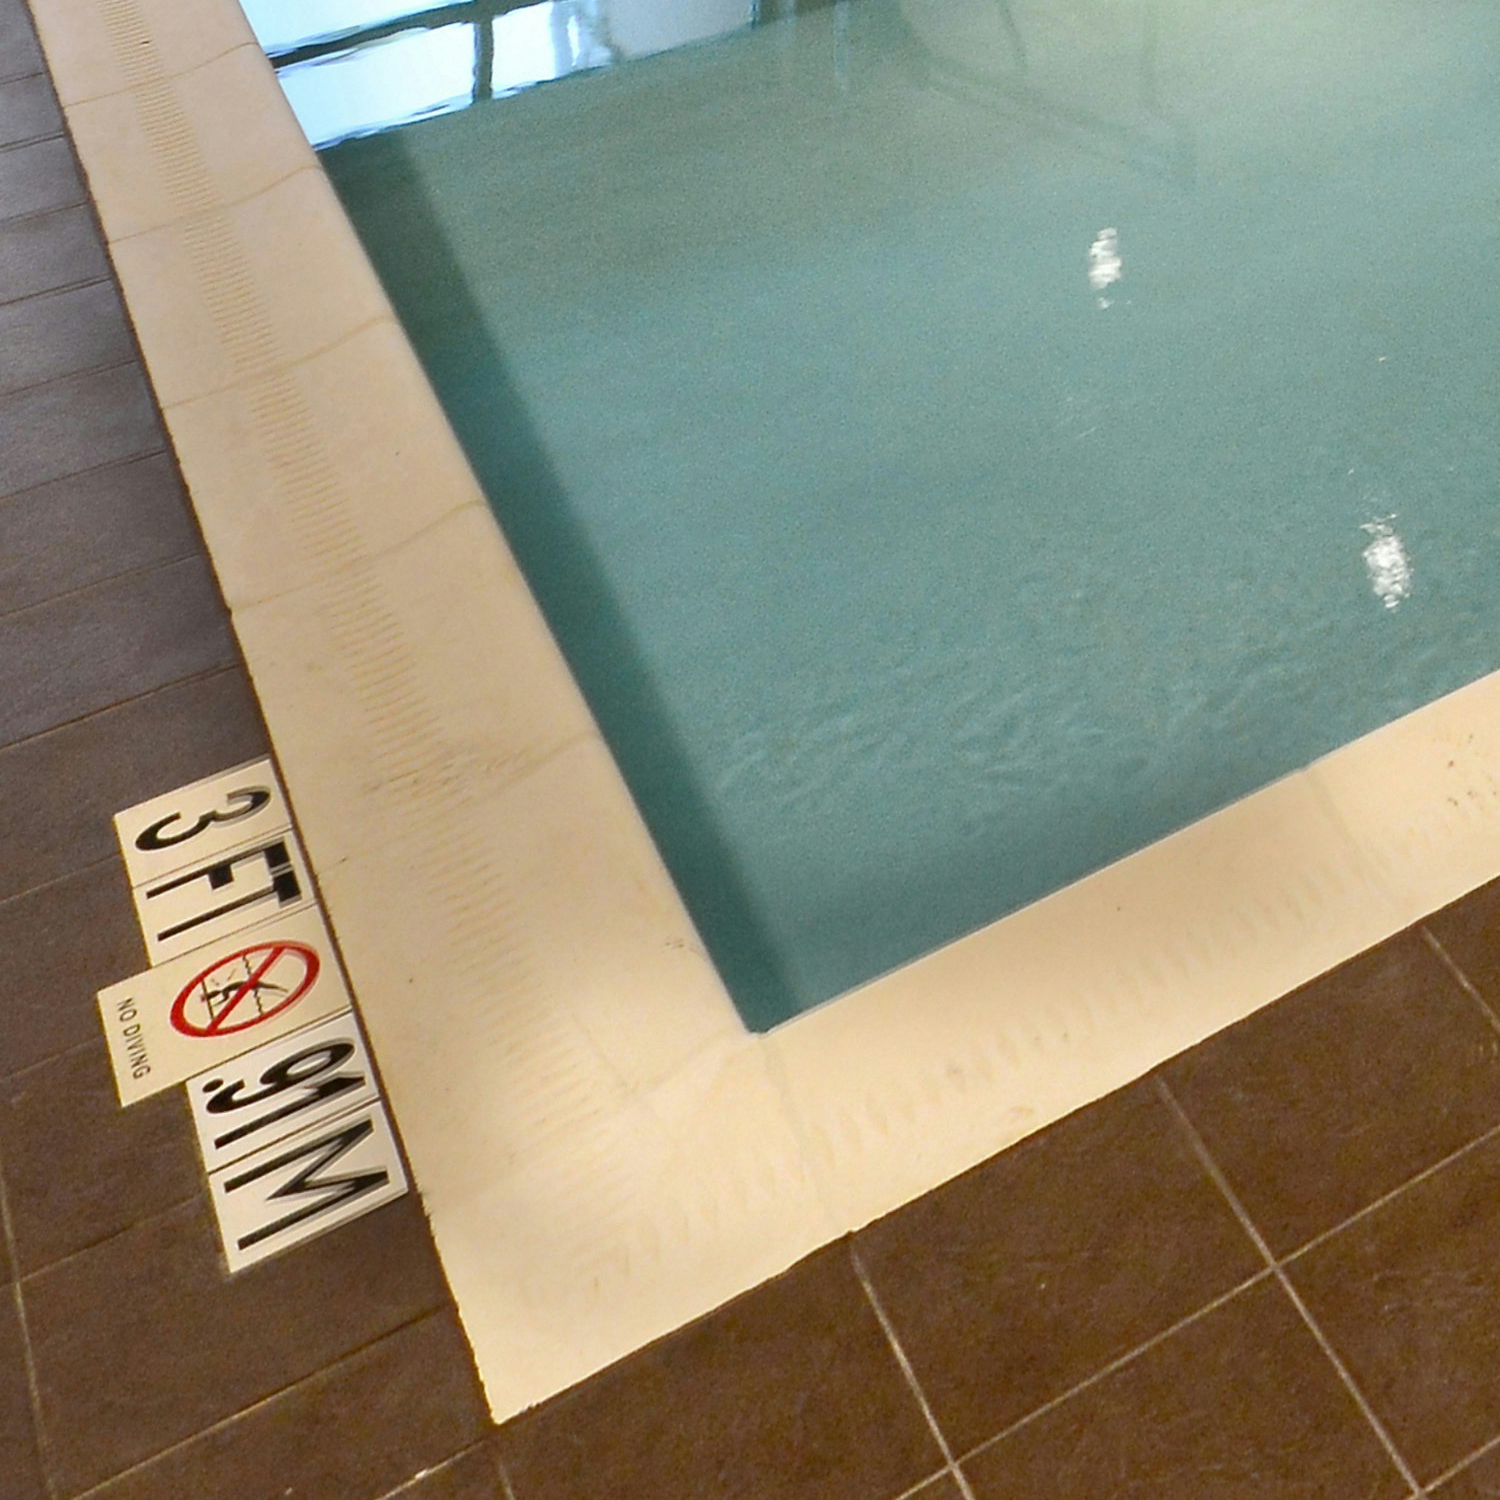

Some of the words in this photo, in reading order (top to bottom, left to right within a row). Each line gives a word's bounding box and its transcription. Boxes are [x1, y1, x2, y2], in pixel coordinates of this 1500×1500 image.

[135, 785, 272, 851] 3
[146, 838, 302, 942] FT
[117, 997, 138, 1022] NO
[123, 1023, 151, 1080] DIVING
[223, 1114, 390, 1251] M
